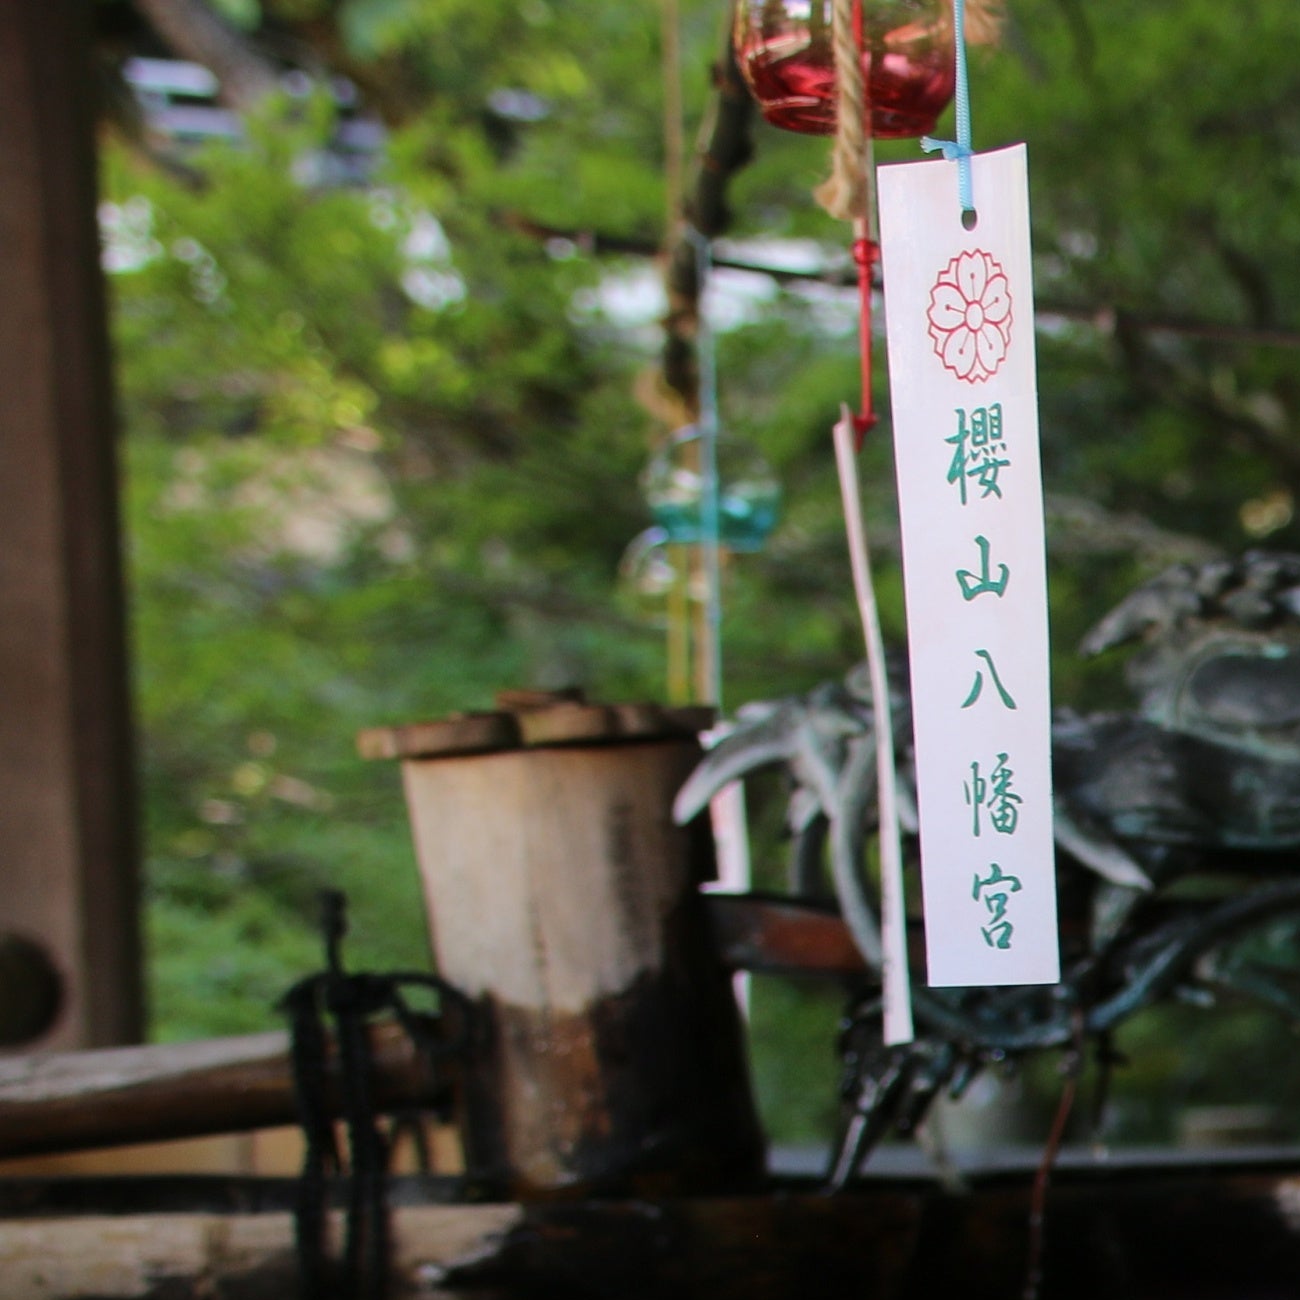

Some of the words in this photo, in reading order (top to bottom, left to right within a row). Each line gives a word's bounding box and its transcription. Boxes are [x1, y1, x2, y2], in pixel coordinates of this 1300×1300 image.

[946, 403, 1023, 952] 櫻山八幡宮
